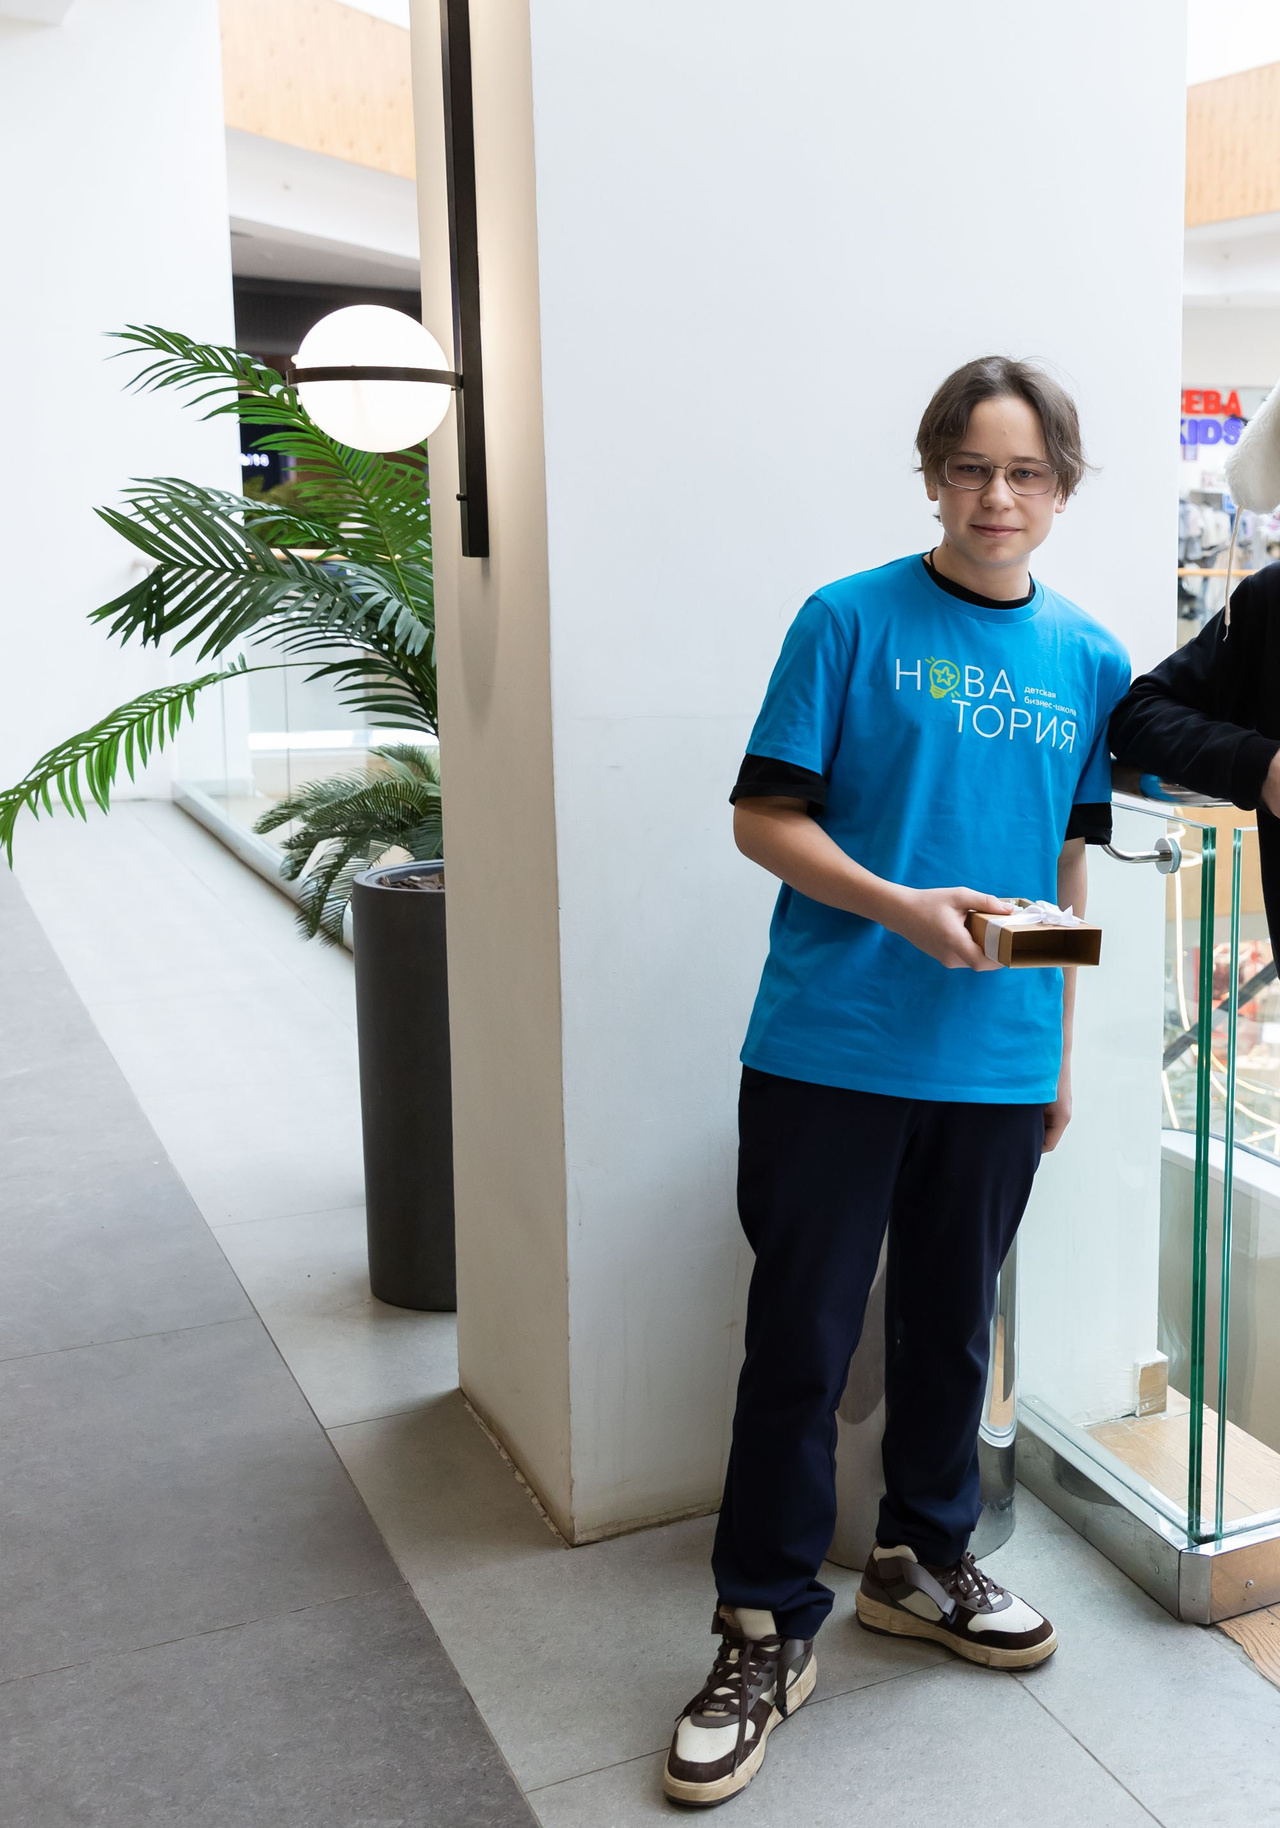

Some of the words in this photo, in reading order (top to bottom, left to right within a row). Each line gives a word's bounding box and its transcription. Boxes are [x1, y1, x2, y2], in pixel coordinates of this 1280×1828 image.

[1181, 389, 1243, 418] ЕВА
[1024, 686, 1057, 699] детская
[1024, 695, 1077, 717] бизнес-школа
[951, 699, 1077, 754] ТОРИЯ
